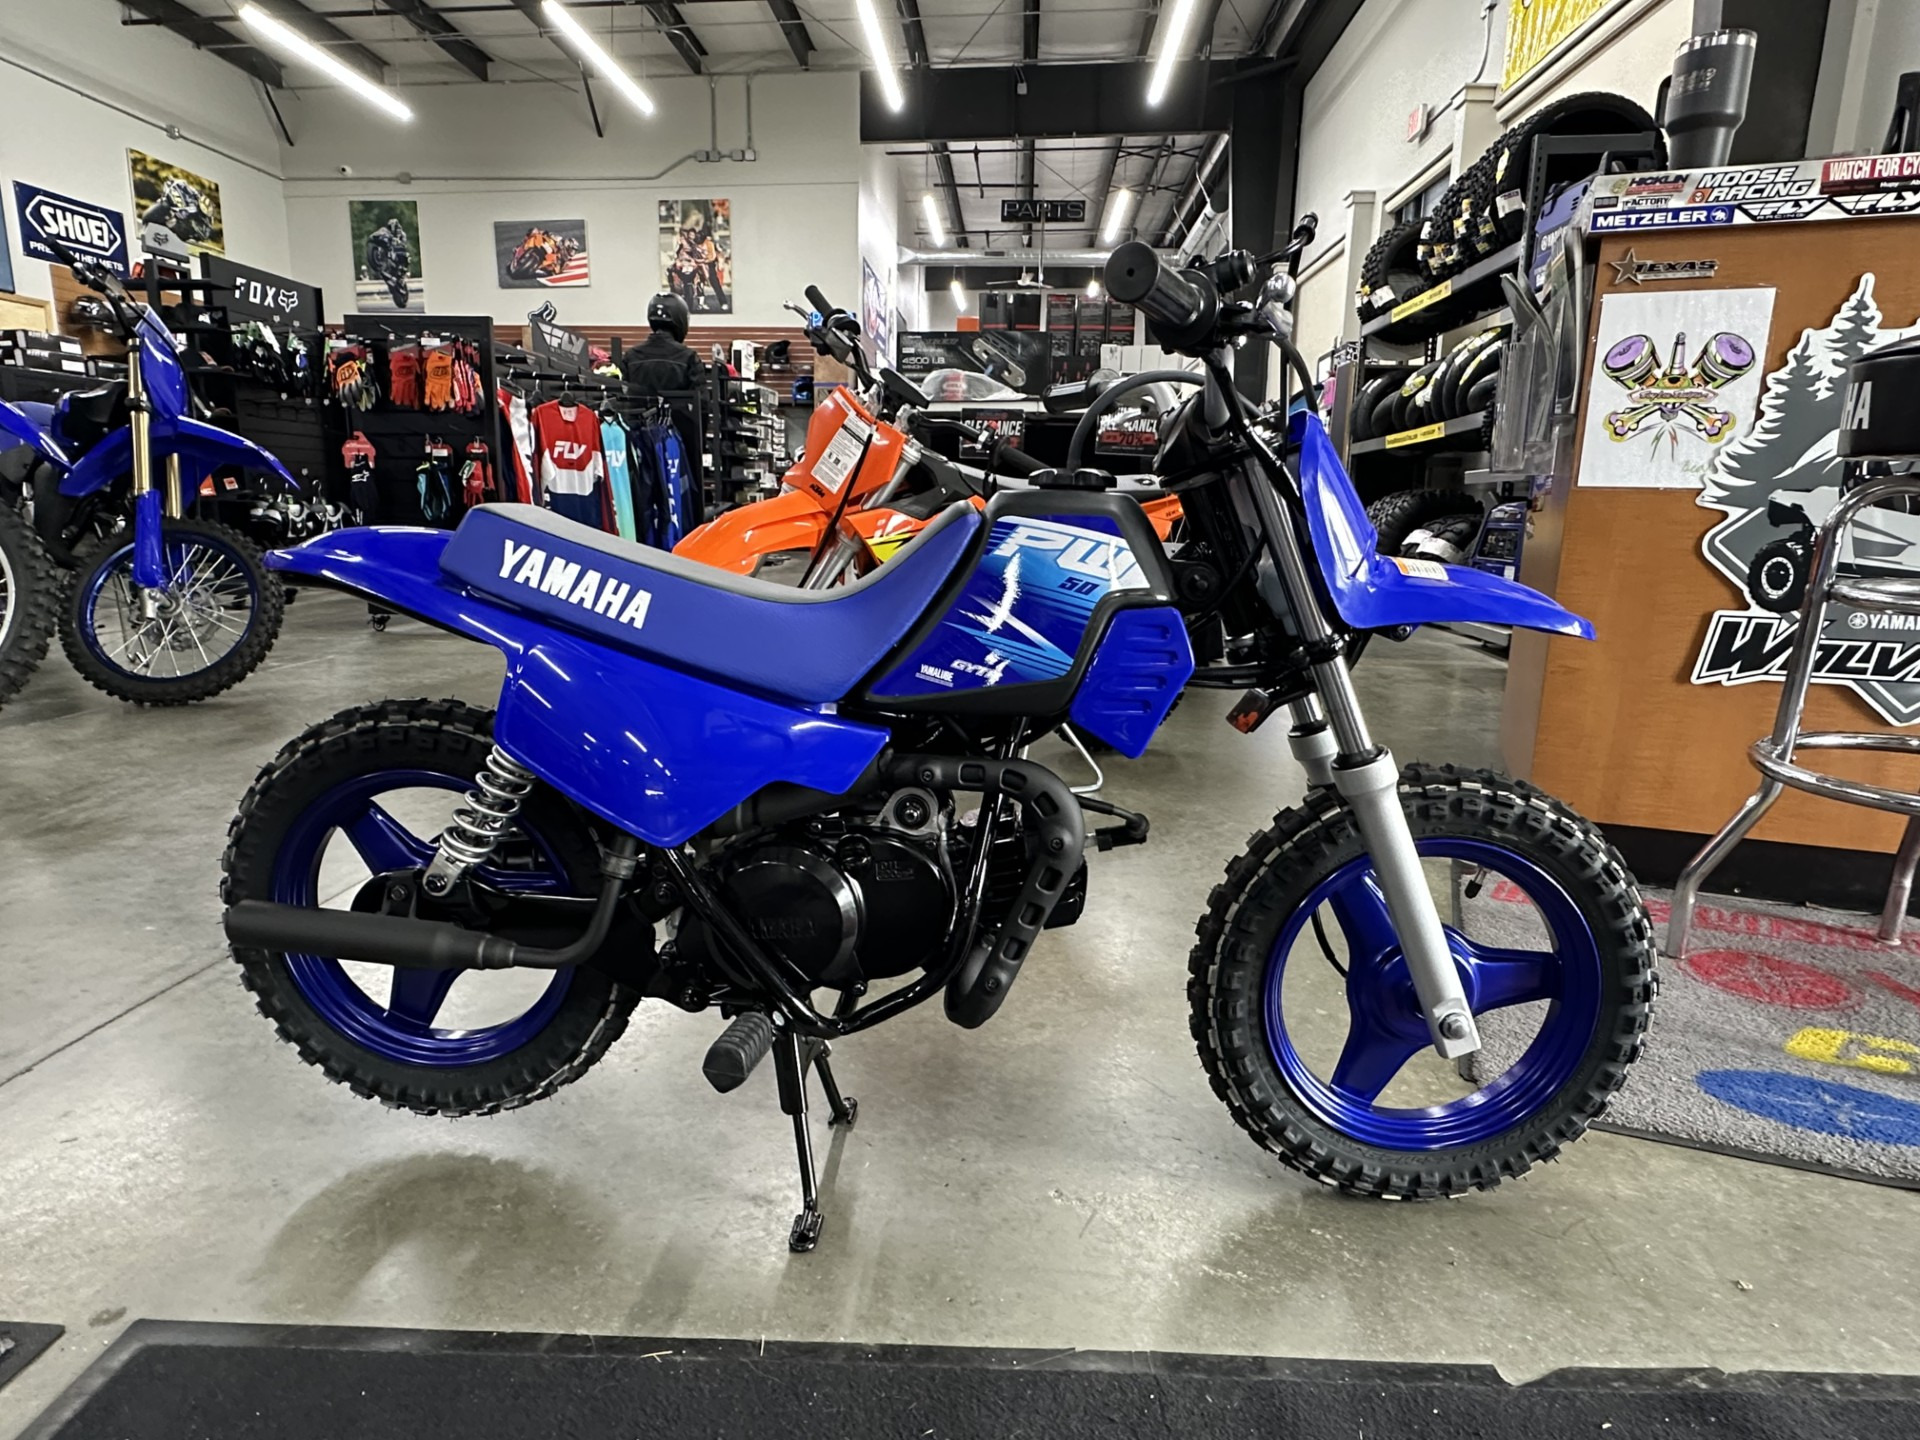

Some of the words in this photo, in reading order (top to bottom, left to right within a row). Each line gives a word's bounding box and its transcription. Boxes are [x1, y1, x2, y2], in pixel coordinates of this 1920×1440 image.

[1699, 166, 1797, 188] MOOSE
[1829, 160, 1871, 180] WATCH
[1874, 158, 1900, 177] FOR
[1902, 156, 1920, 176] CY
[1630, 174, 1688, 186] HICKLIN
[1711, 181, 1813, 203] RACING
[1833, 191, 1920, 210] FLY
[1004, 201, 1084, 218] PARTS
[1625, 197, 1668, 207] FACTORY
[1743, 200, 1818, 216] FLY
[40, 204, 109, 248] SHOEI
[1596, 210, 1706, 227] METZELER
[29, 241, 80, 261] PREM
[1634, 261, 1717, 273] TEXAS
[234, 276, 276, 308] FOX
[539, 322, 585, 354] FLY
[902, 356, 929, 364] 4500
[932, 356, 945, 364] LB
[1841, 381, 1872, 430] HA
[964, 420, 1022, 436] CLEANCE
[553, 441, 587, 459] FLY
[994, 526, 1137, 580] PW
[499, 539, 652, 630] YAMAHA
[1057, 577, 1100, 596] 50
[1870, 614, 1920, 630] YAMA
[921, 663, 954, 682] YAMALUBE
